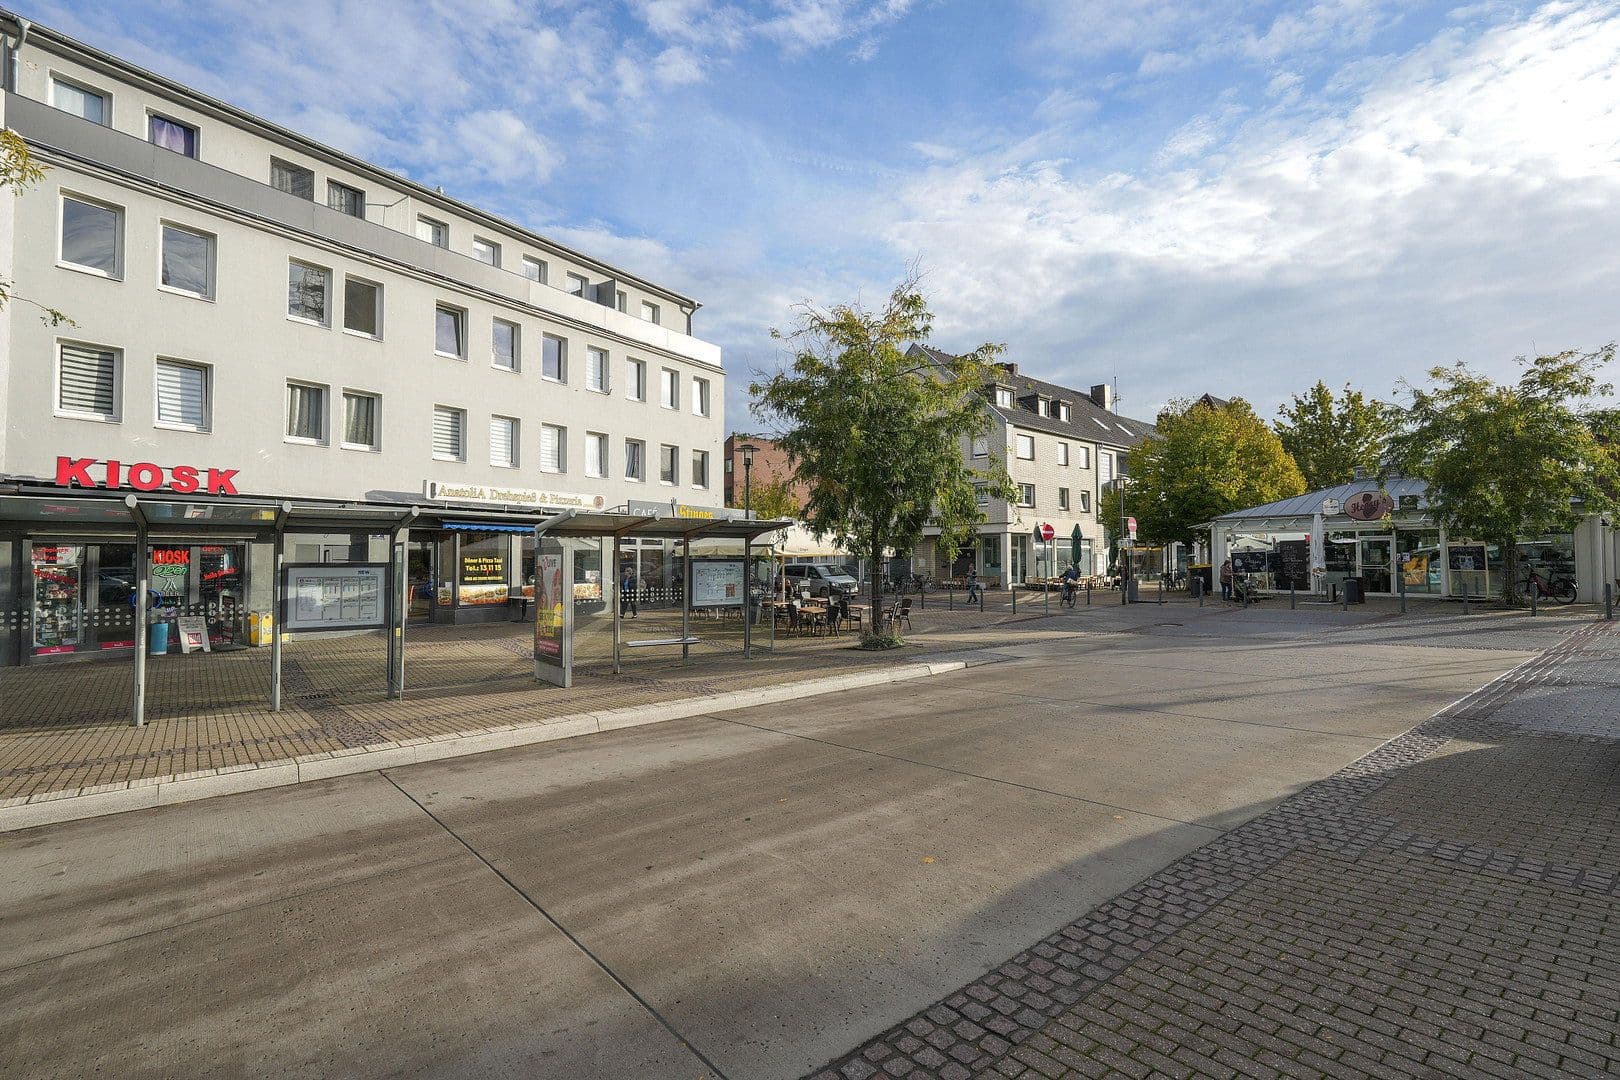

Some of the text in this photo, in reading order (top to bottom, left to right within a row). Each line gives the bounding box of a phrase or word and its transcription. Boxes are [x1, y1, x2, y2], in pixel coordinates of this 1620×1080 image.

[55, 456, 240, 495] KIOSK
[539, 494, 547, 504] &
[550, 493, 582, 505] Pizzeria
[153, 549, 190, 565] KIOSK
[153, 565, 188, 577] Open
